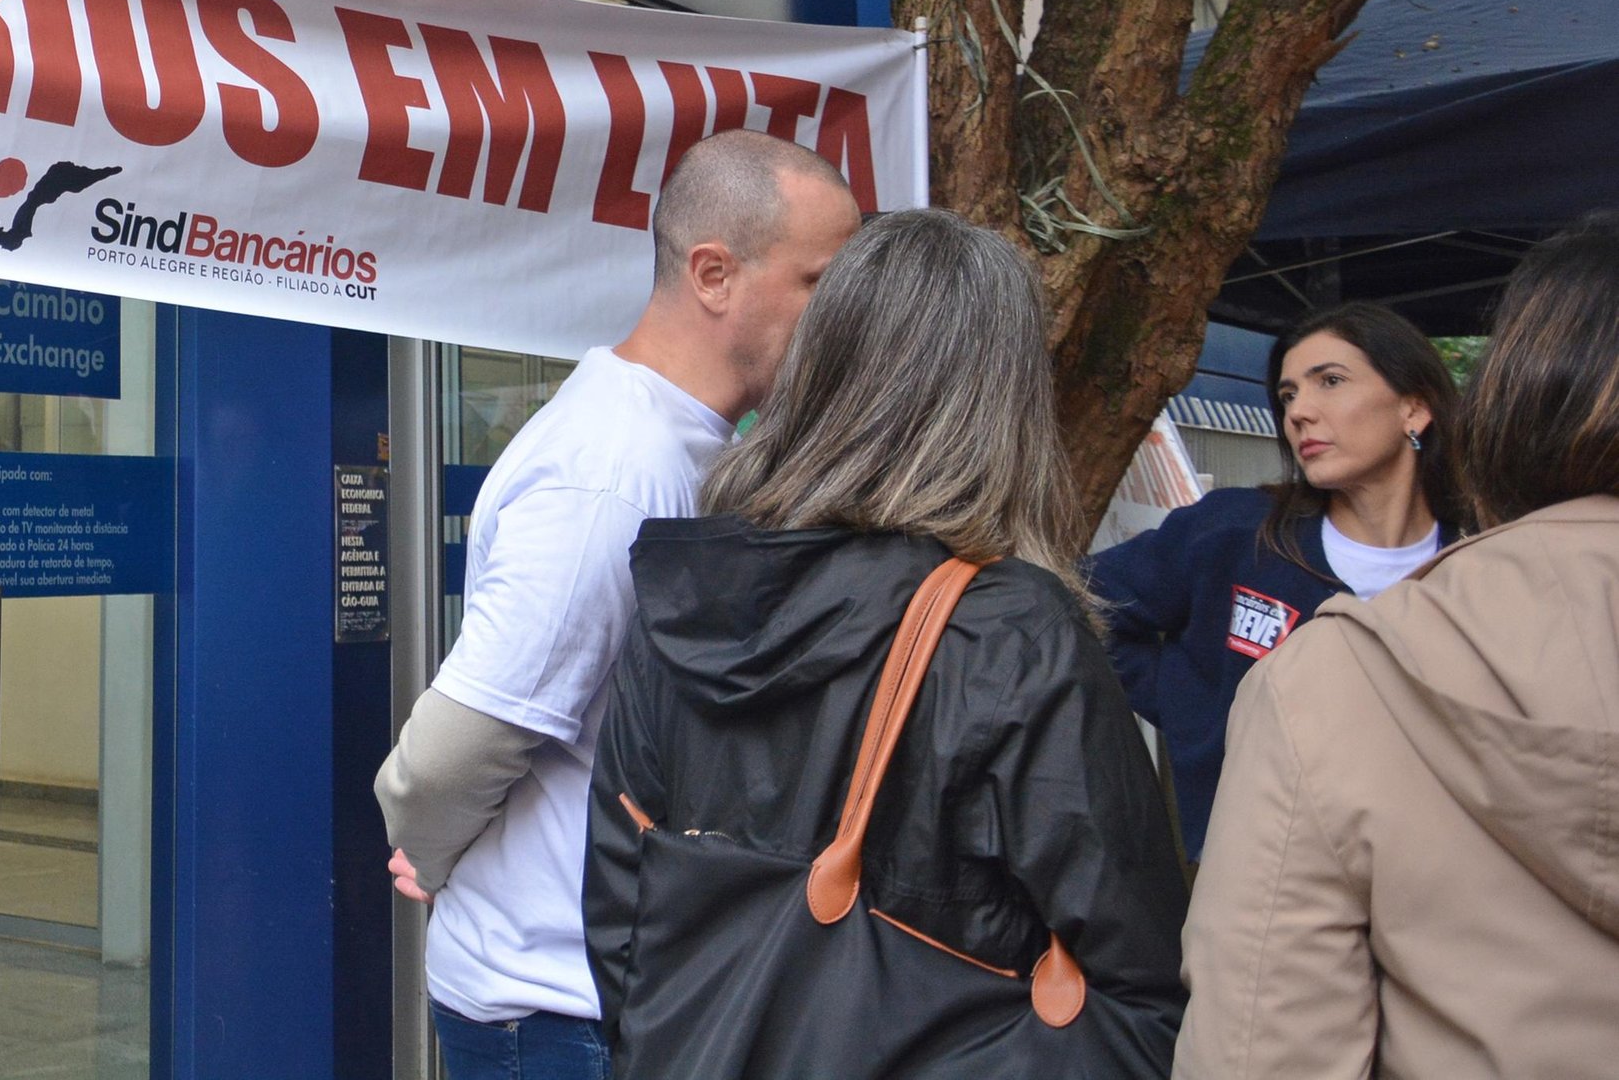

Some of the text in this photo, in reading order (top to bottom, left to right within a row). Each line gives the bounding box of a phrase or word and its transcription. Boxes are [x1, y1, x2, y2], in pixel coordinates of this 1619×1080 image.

[335, 6, 565, 214] EM
[90, 197, 378, 285] SindBancários
[87, 247, 136, 266] PORTO
[140, 256, 195, 276] ALEGRE
[200, 264, 208, 278] E
[212, 266, 264, 286] REGIÃO
[276, 276, 329, 295] FILIADO
[345, 284, 377, 301] CUT
[29, 471, 53, 482] com:
[341, 474, 364, 485] CAIXA
[2, 507, 20, 516] com
[23, 502, 57, 517] detector
[59, 504, 69, 517] de
[71, 504, 94, 517] metal
[342, 503, 372, 514] FEDERAL
[8, 520, 19, 534] de
[21, 521, 33, 534] TV
[35, 521, 82, 534] monitorado
[93, 521, 128, 534] distância
[57, 539, 68, 551] 24
[71, 537, 94, 551] horas
[342, 536, 365, 546] NESTA
[28, 555, 38, 568] de
[41, 554, 72, 568] retardo
[74, 555, 84, 567] de
[87, 557, 115, 571] tempo,
[342, 566, 379, 576] PERMITIDA
[20, 576, 35, 586] sua
[37, 571, 74, 585] abertura
[342, 580, 385, 592] ENTRADA DE
[1229, 604, 1281, 649] REVE
